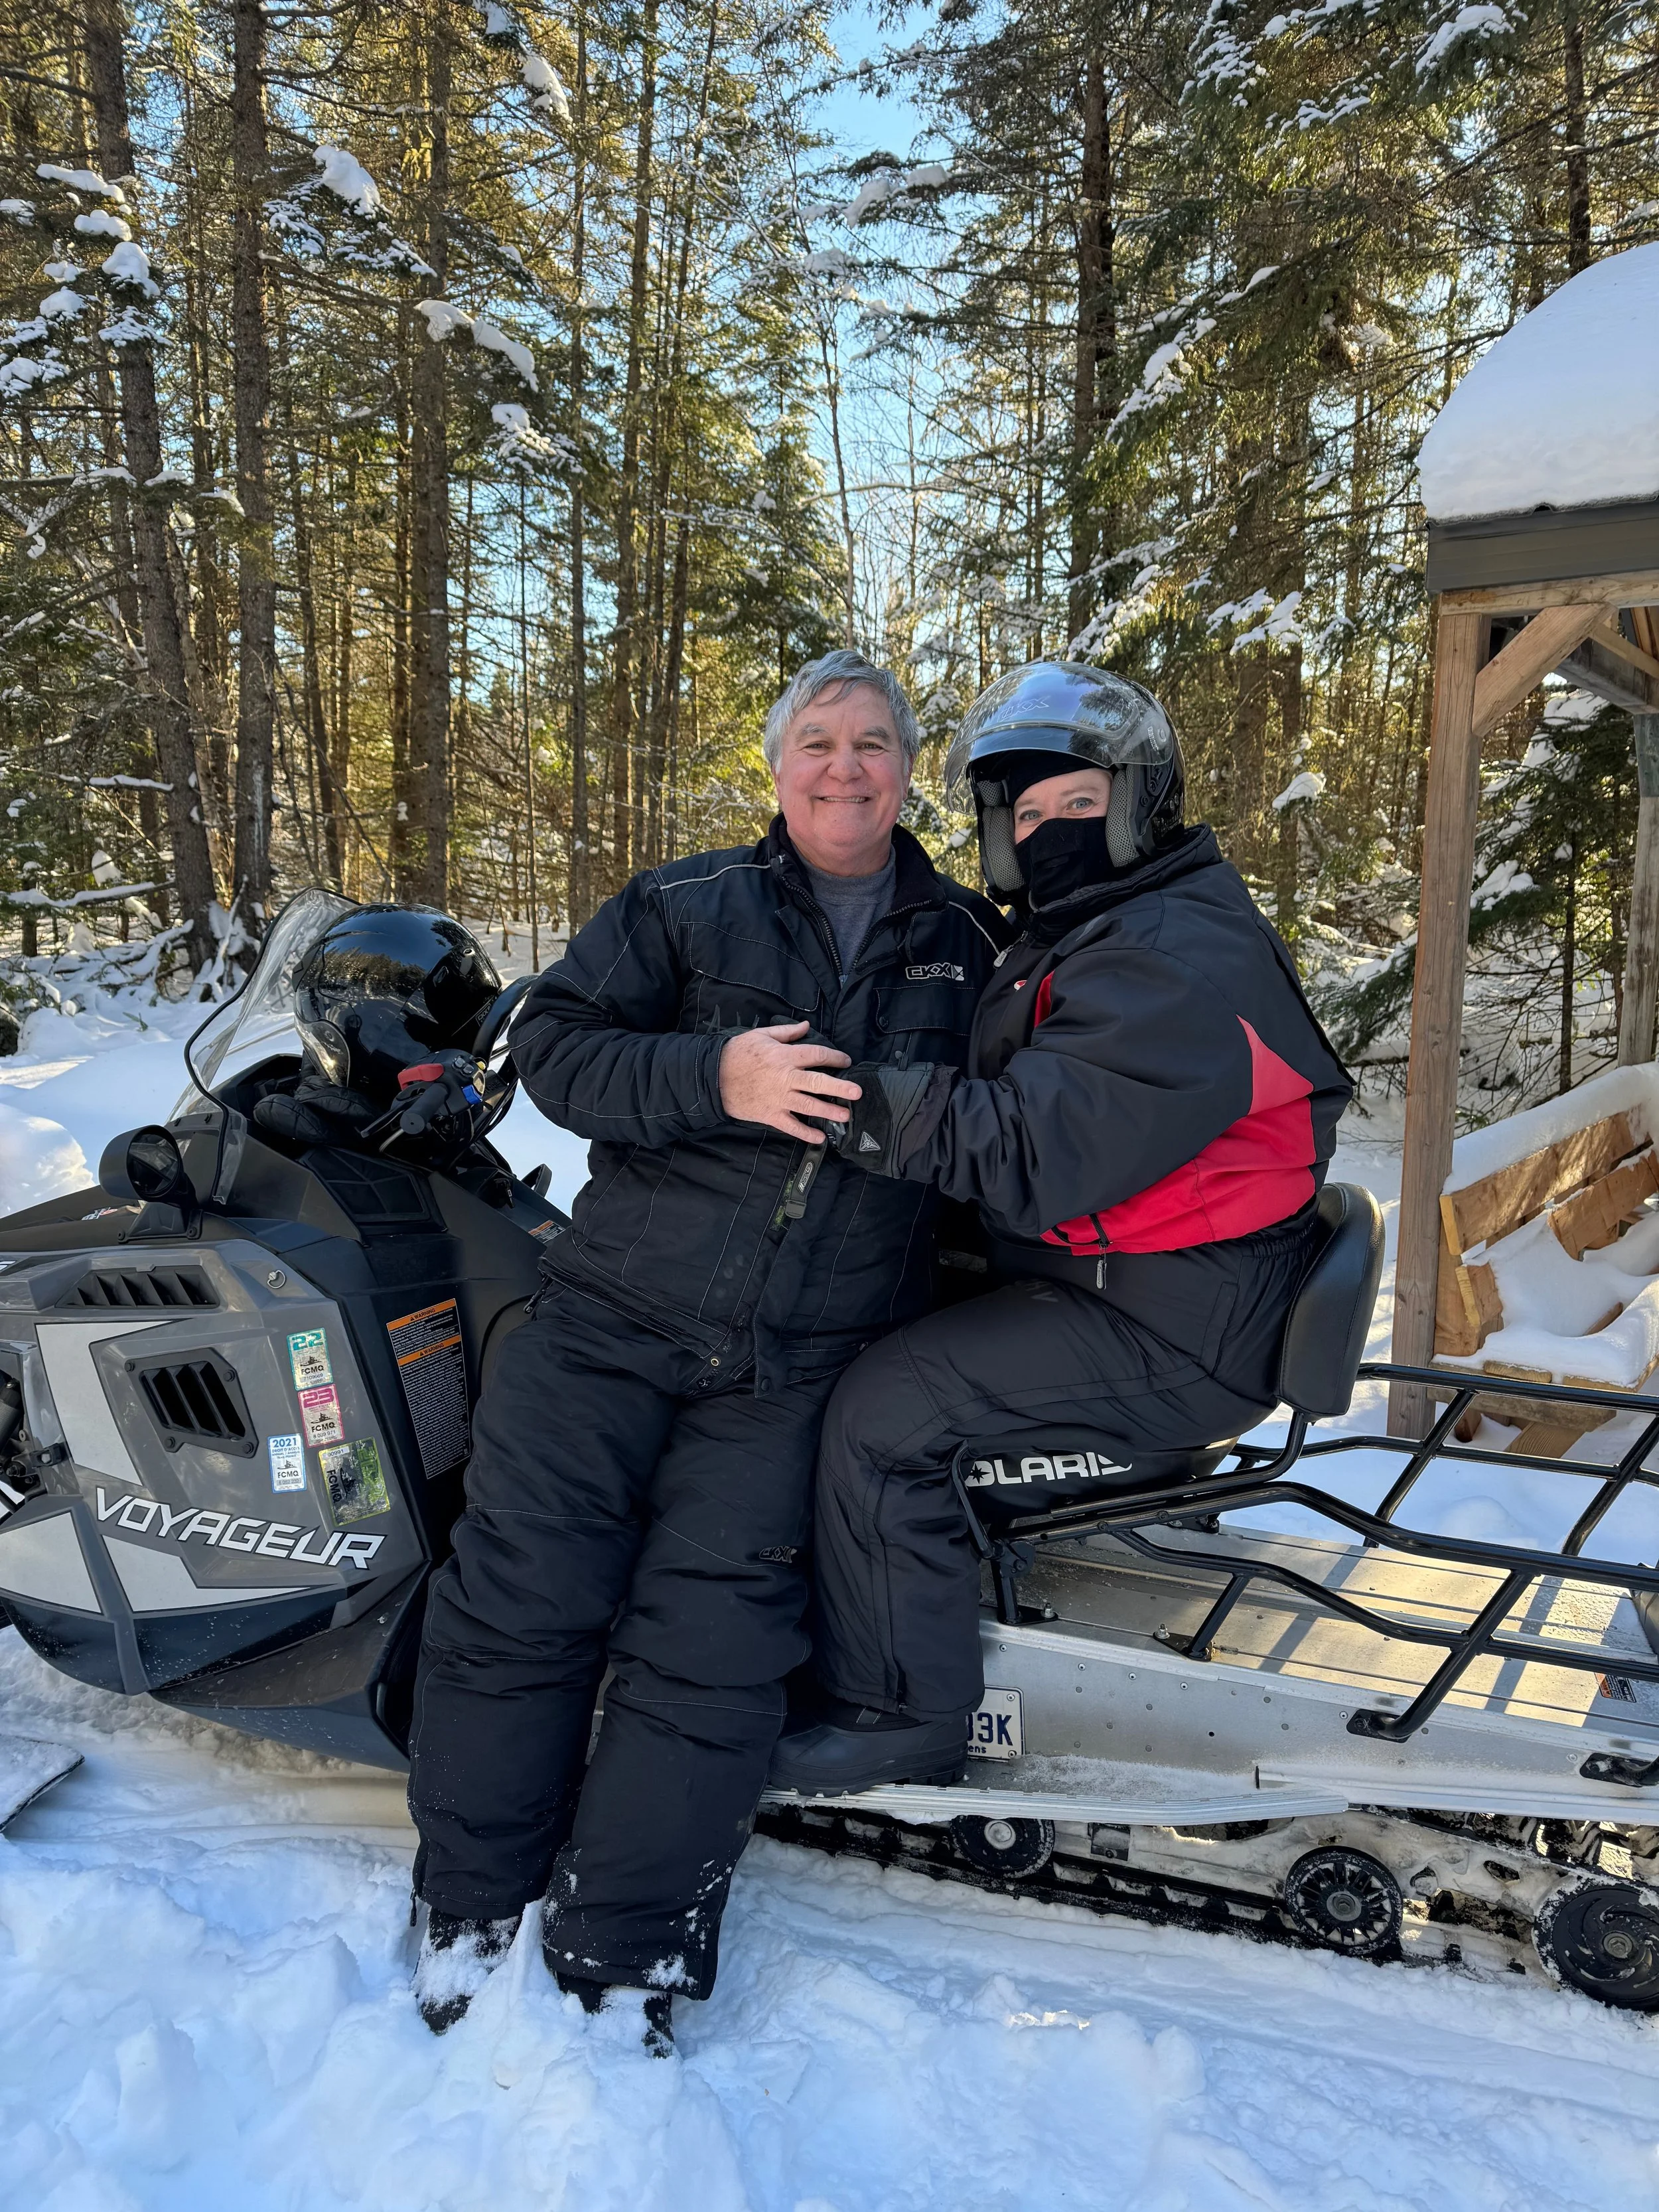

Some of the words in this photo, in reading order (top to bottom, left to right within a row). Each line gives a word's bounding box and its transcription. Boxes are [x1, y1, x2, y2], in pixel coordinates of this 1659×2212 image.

[906, 962, 952, 980] CKX
[414, 1308, 435, 1320] WARNING
[292, 1333, 324, 1351] 22
[424, 1343, 444, 1355] WARNING
[301, 1365, 325, 1374] FCMQ
[303, 1388, 334, 1408] 23
[311, 1422, 336, 1432] FCMQ
[273, 1438, 297, 1447] 2021
[964, 1452, 1132, 1487] OLARIS
[326, 1469, 343, 1504] FCMQ
[96, 1488, 386, 1568] VOYAGEUR
